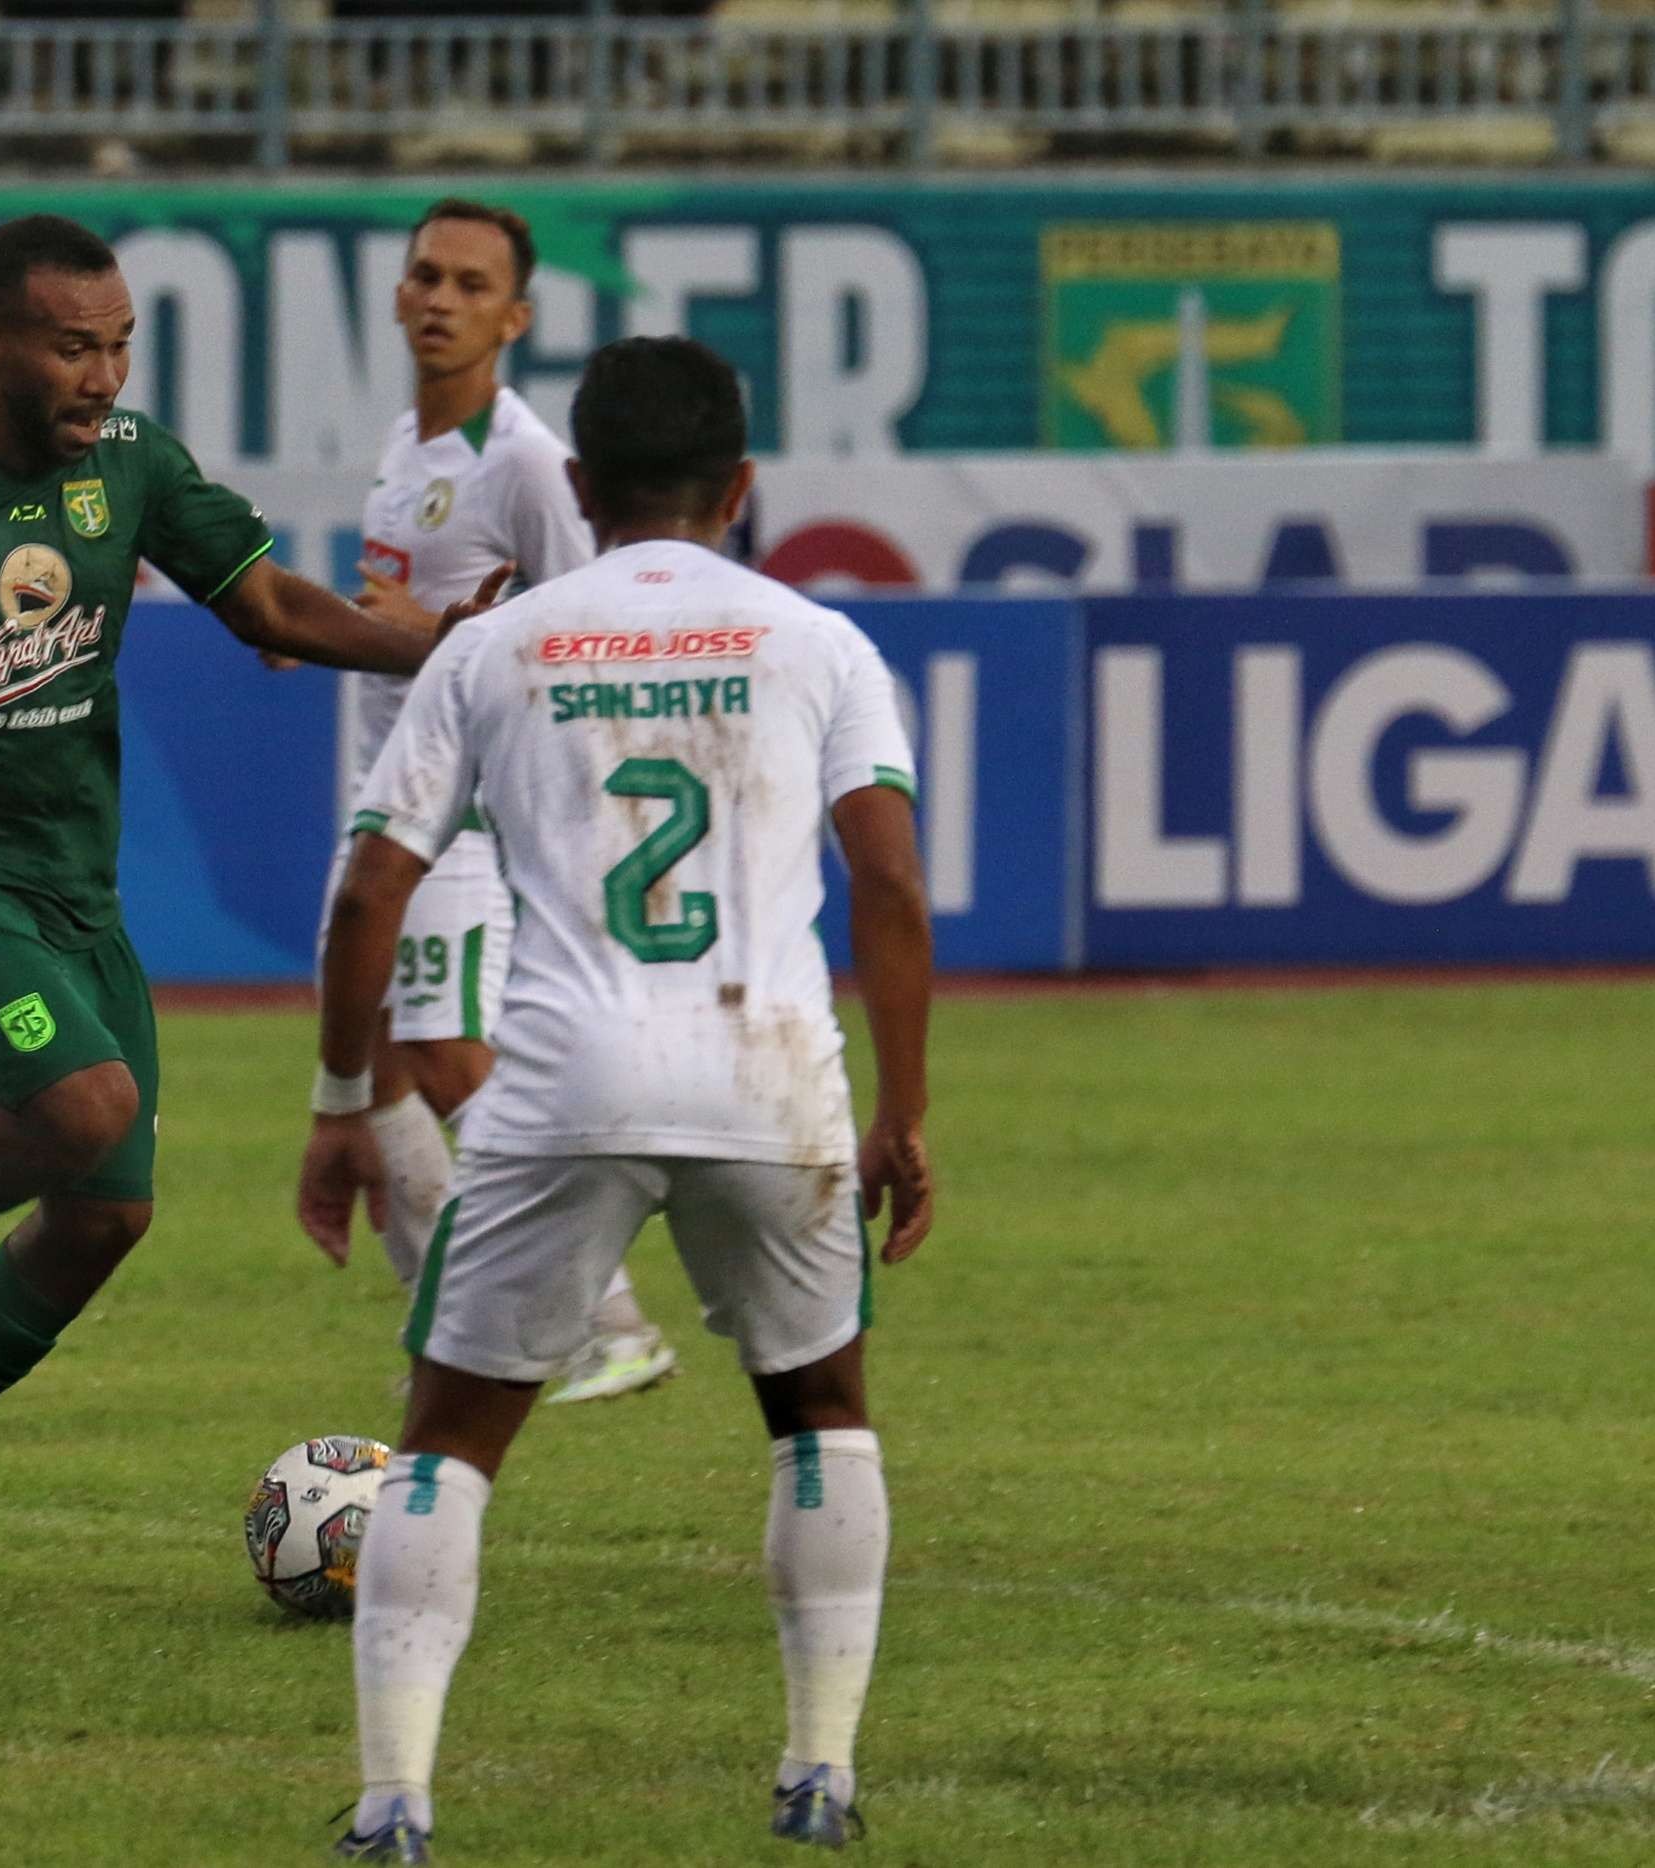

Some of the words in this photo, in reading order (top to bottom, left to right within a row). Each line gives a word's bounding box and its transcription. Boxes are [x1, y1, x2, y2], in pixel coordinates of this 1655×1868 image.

[43, 603, 107, 664] Api
[542, 632, 652, 662] EXTRA
[664, 629, 755, 657] JOSS
[7, 706, 58, 730] lebih
[548, 675, 751, 723] SANJAYA
[1092, 642, 1655, 910] LIGA
[603, 757, 719, 964] 2
[397, 933, 449, 987] 99
